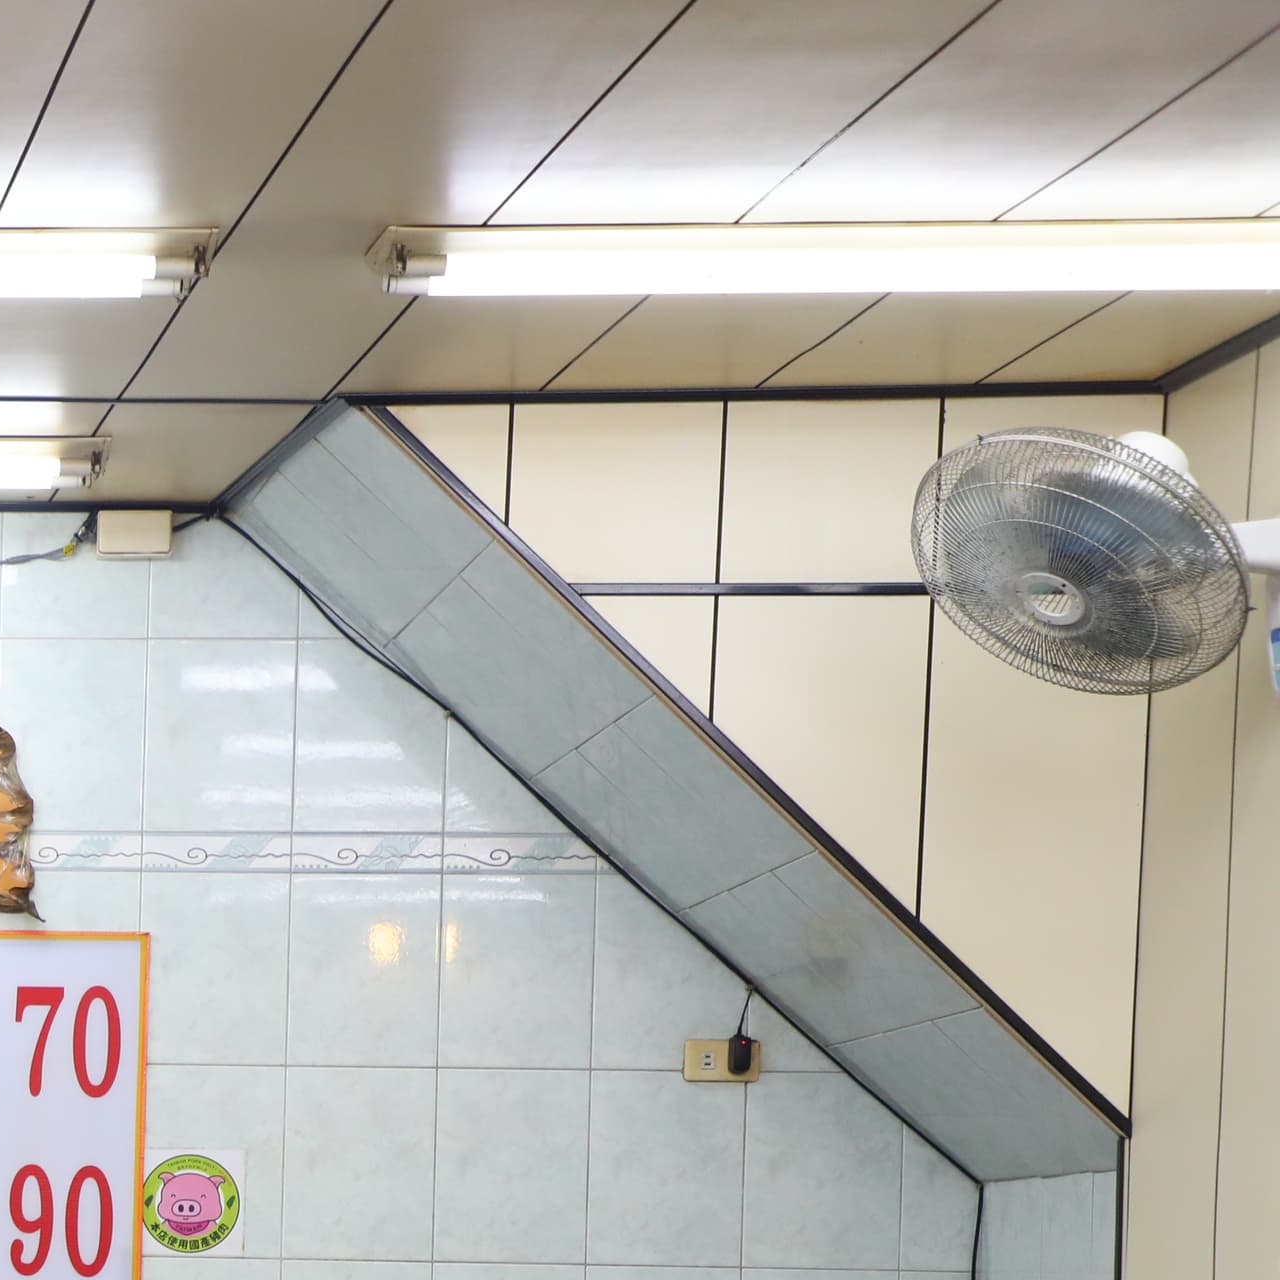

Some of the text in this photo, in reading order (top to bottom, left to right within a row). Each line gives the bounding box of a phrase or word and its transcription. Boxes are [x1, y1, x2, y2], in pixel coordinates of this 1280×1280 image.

[151, 1222, 229, 1250] 本店使用國產豬肉
